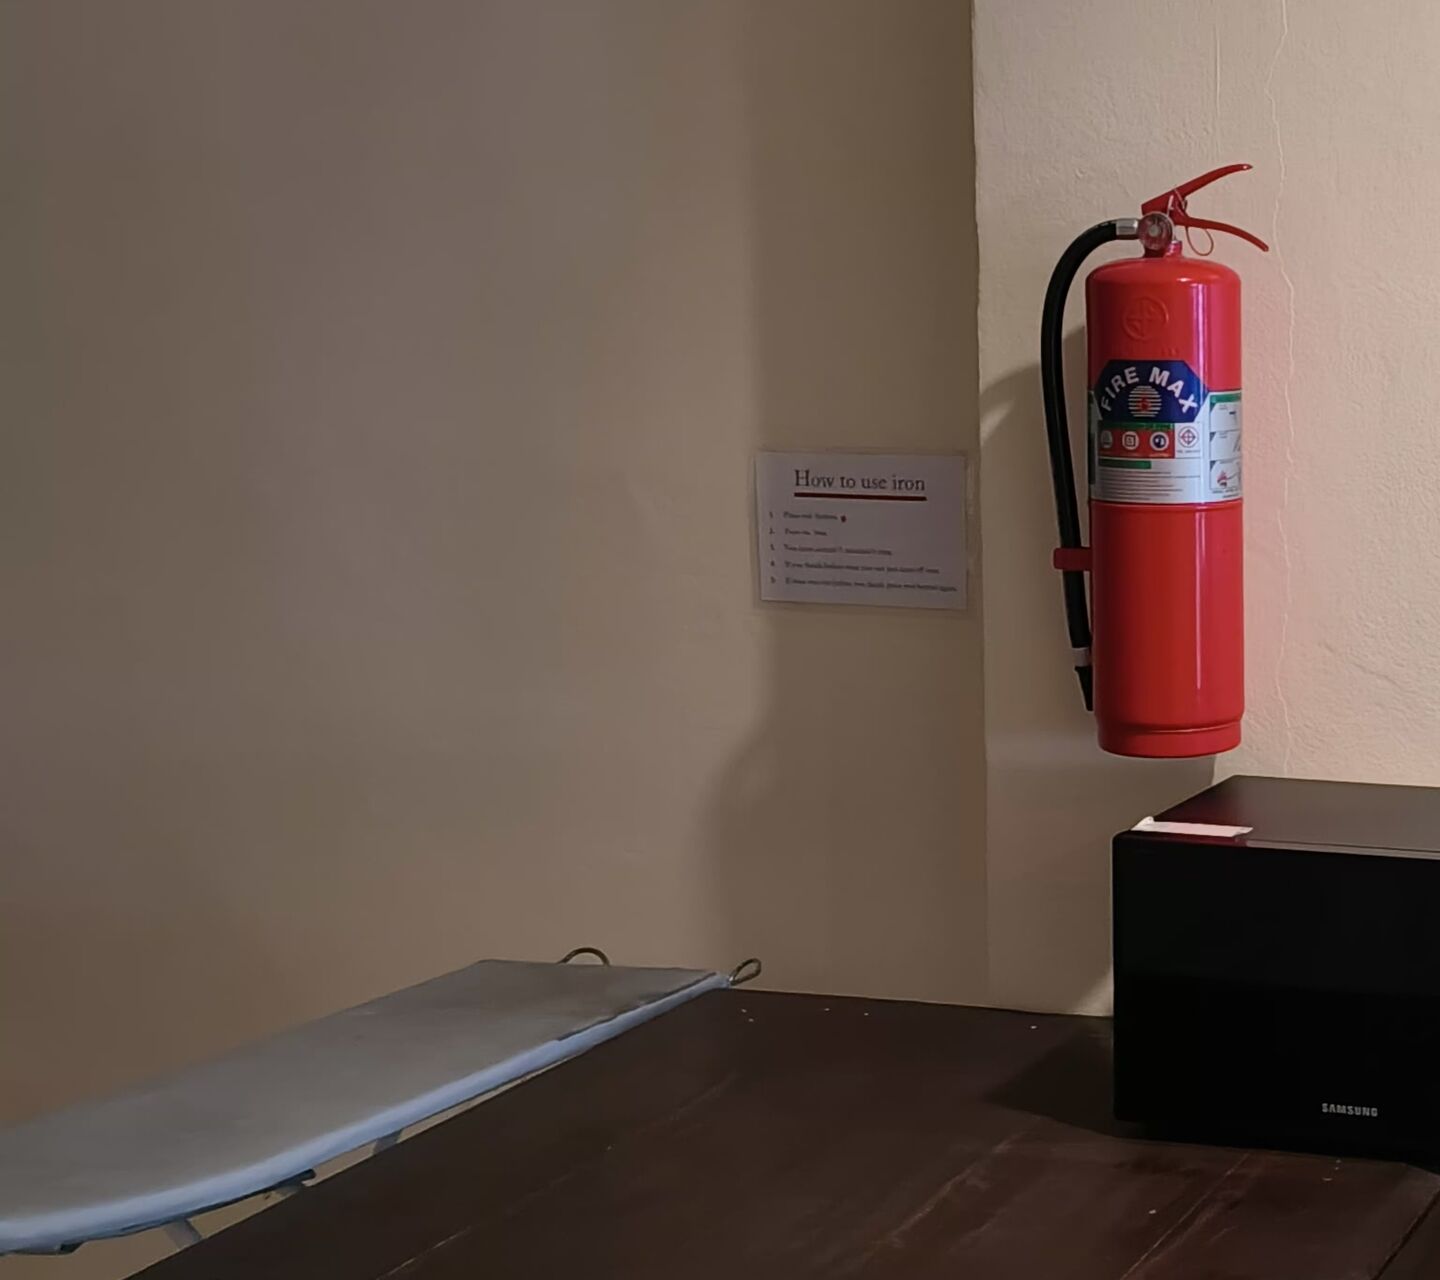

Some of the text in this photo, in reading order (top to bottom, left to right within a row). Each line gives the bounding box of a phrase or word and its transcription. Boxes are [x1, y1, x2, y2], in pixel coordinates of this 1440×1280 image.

[1101, 366, 1199, 413] FIRE MAX
[794, 469, 926, 491] How to use iron
[1321, 1102, 1379, 1117] SAMSUNG
